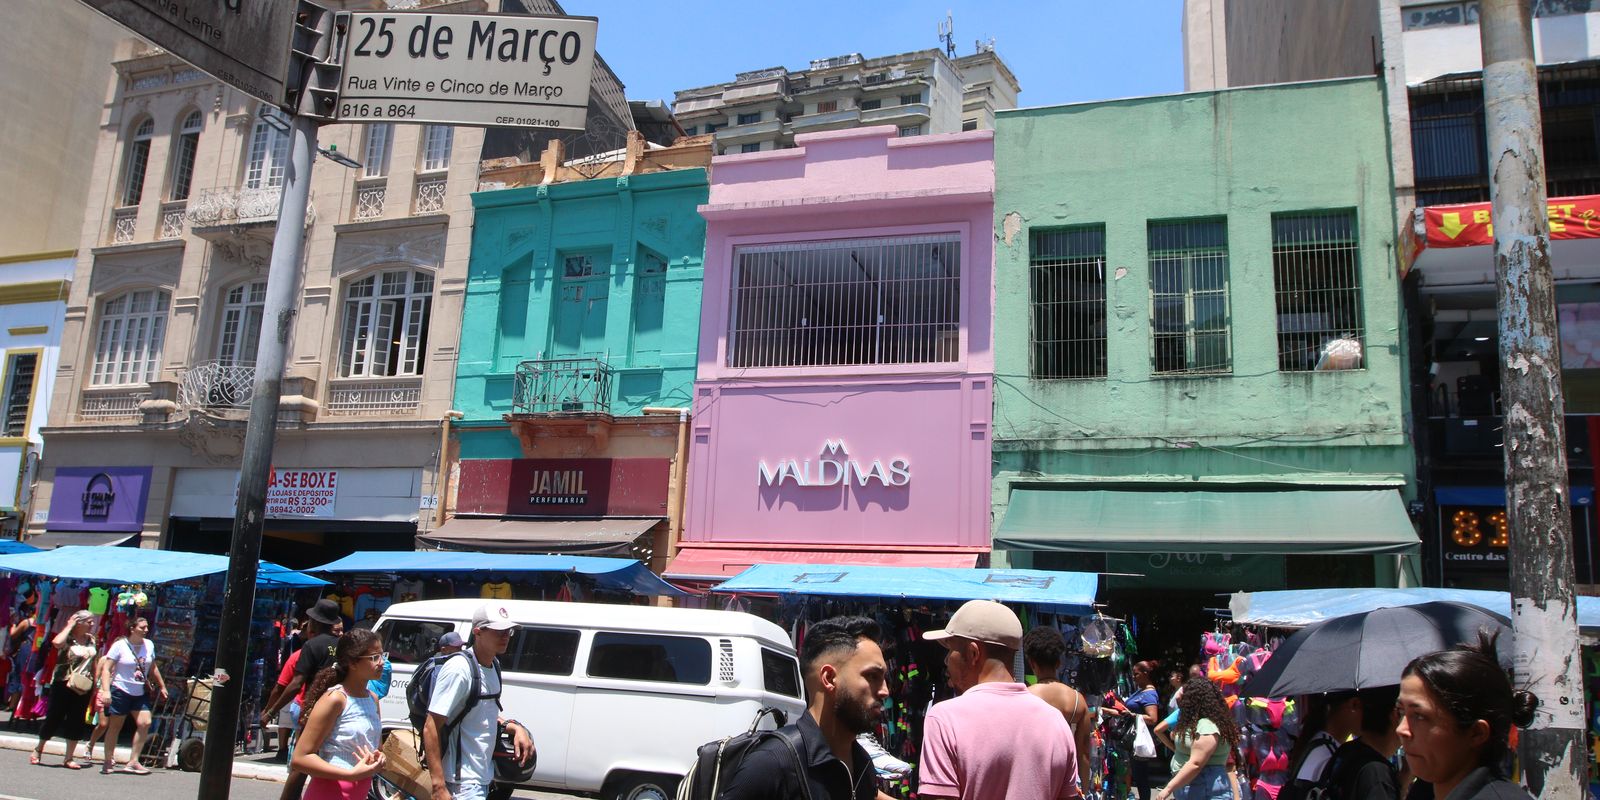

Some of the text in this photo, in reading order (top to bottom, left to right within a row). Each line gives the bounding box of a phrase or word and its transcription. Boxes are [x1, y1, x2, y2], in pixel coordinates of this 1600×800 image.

[183, 7, 222, 39] Leme
[354, 16, 581, 76] 25 de Março
[348, 76, 563, 100] Rua Vinte e Cinco de Março
[341, 104, 416, 118] 816 a 864
[496, 116, 560, 127] CEP 01021-100
[300, 472, 326, 488] BOX
[328, 472, 336, 488] E
[758, 457, 911, 487] MALDIVAS
[530, 470, 588, 495] JAMIL
[288, 497, 300, 506] R$
[301, 497, 327, 506] 3.300
[1445, 552, 1506, 561] Centro das
